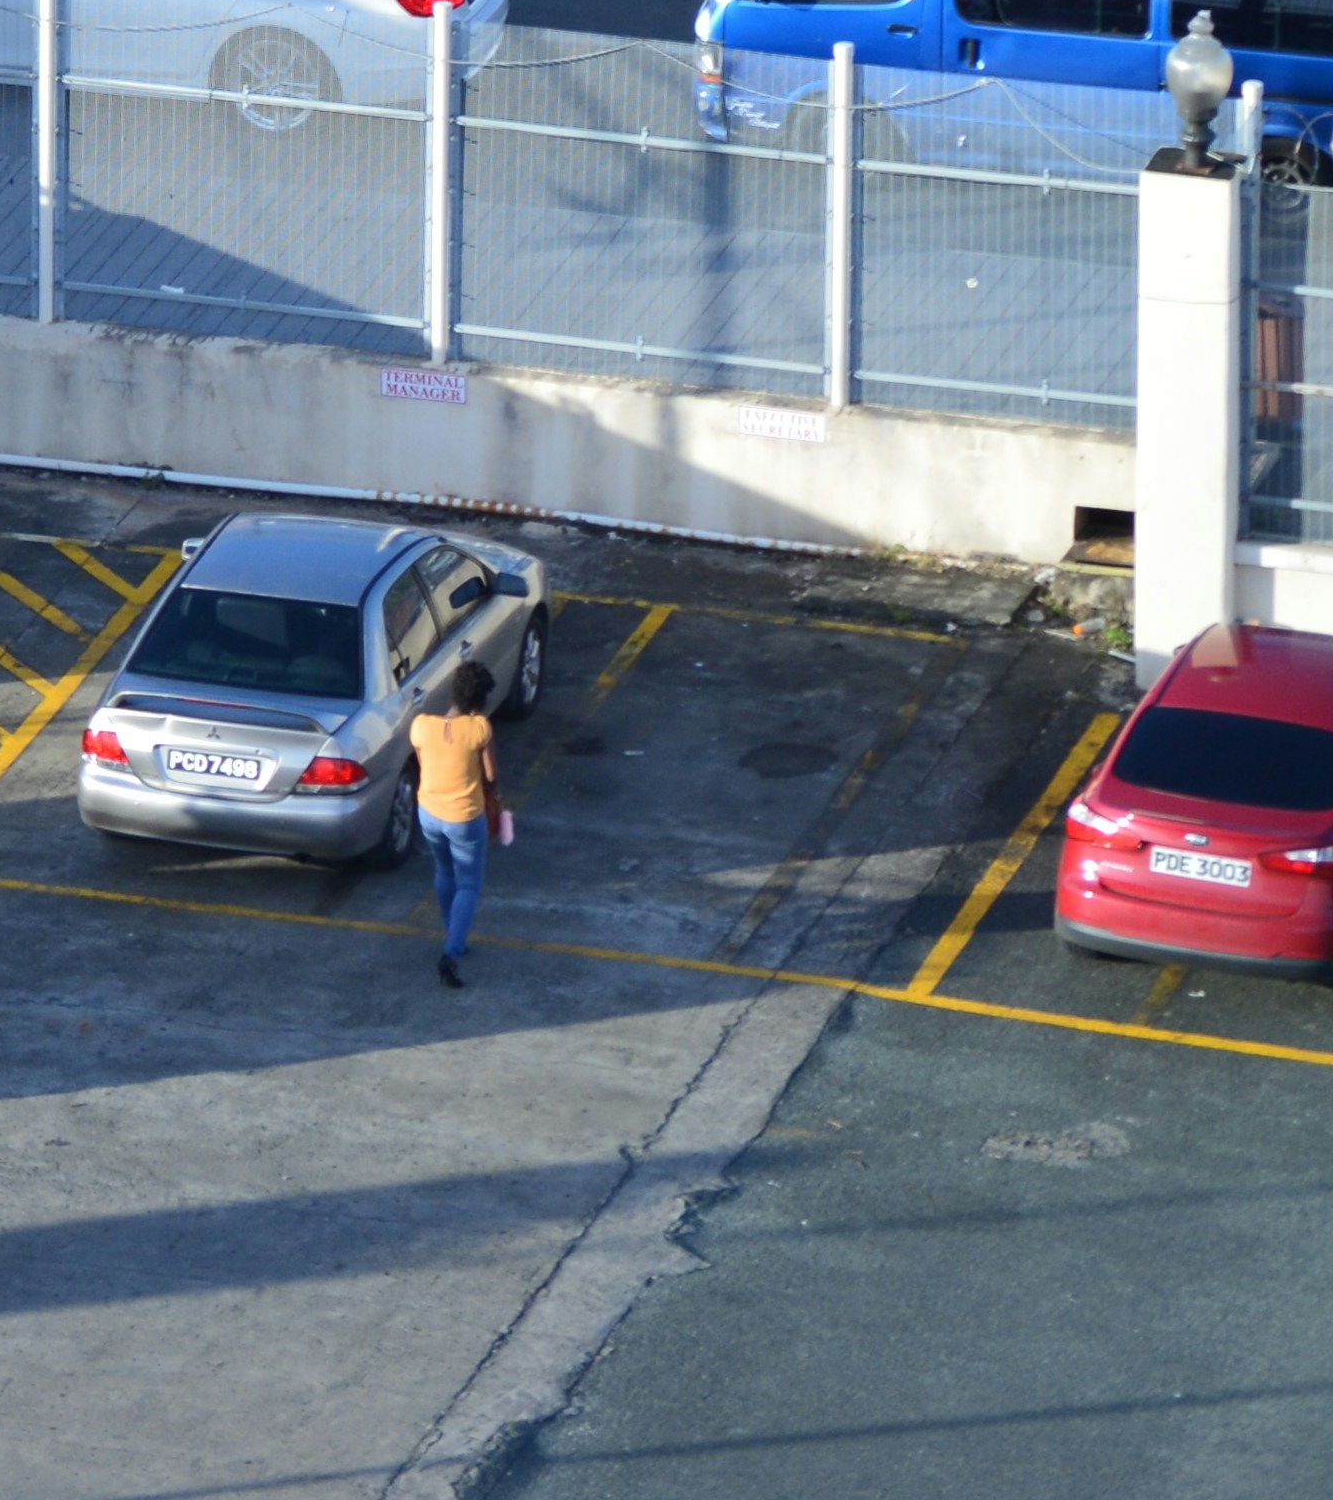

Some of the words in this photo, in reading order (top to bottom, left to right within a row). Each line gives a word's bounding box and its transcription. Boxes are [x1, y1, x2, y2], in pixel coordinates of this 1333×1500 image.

[385, 371, 463, 389] TERMINAL
[386, 383, 461, 401] MANAGER
[1154, 851, 1191, 874] PDE
[1196, 858, 1250, 883] 3003
